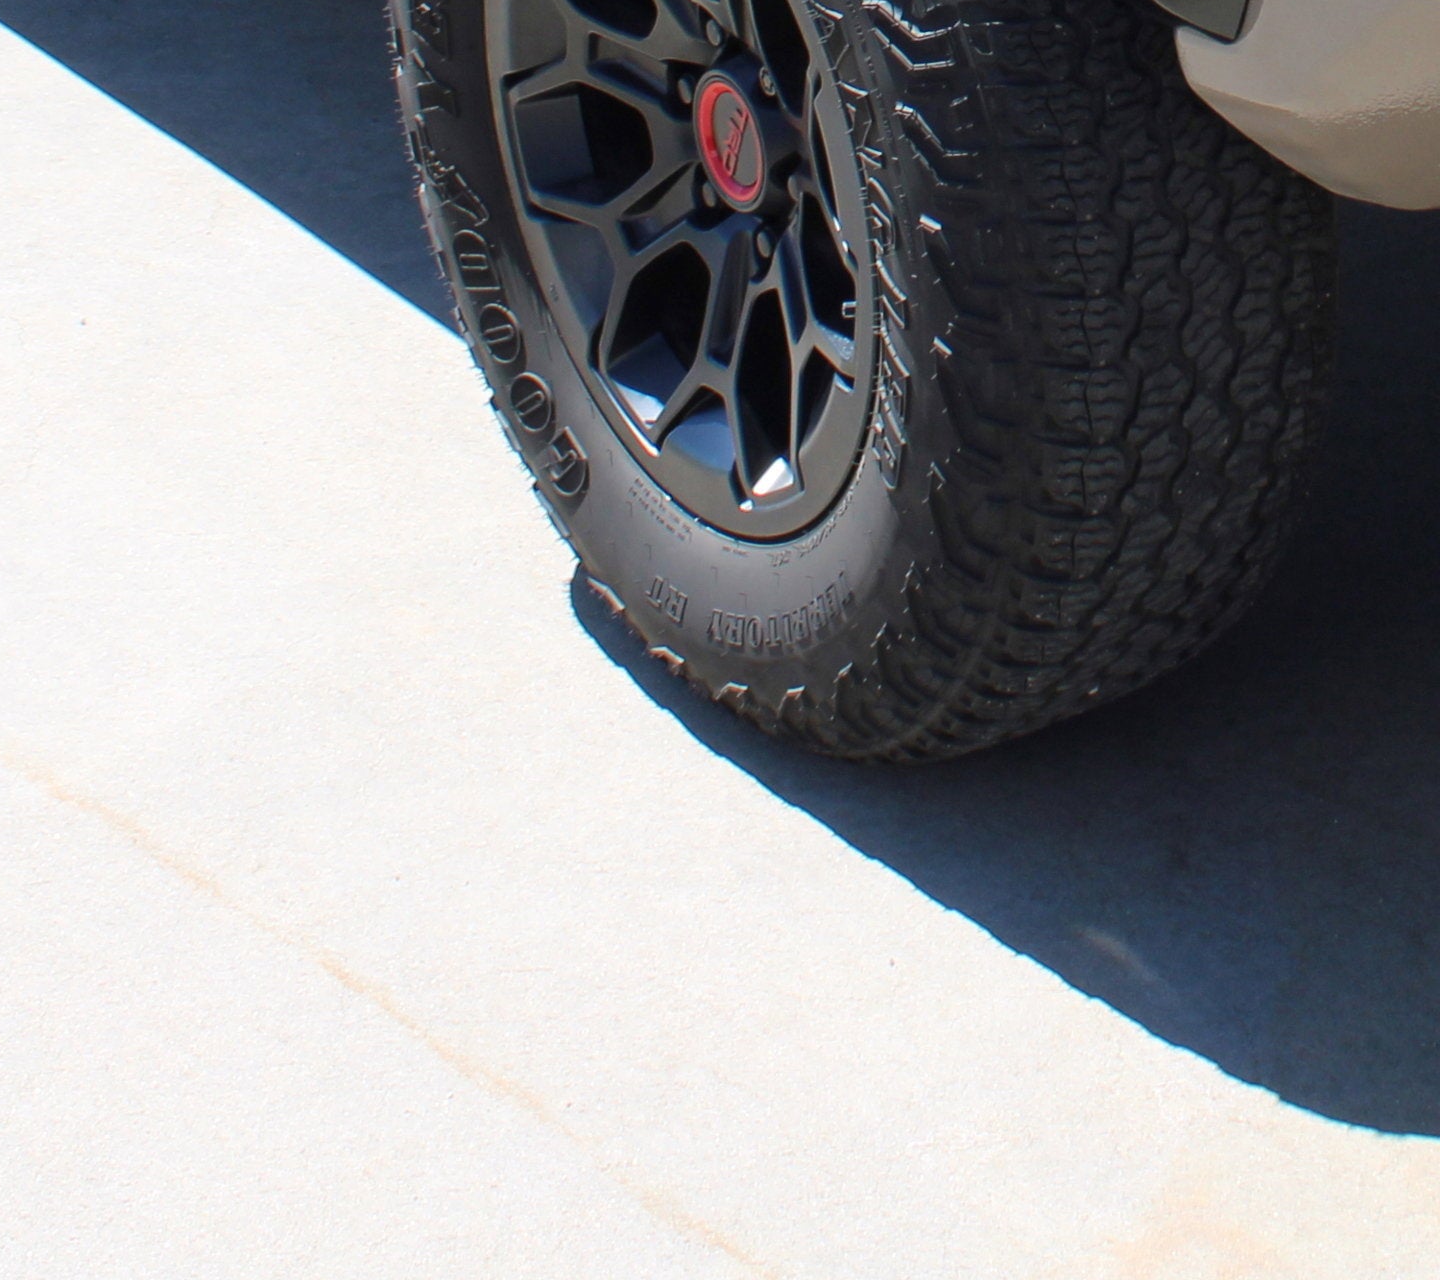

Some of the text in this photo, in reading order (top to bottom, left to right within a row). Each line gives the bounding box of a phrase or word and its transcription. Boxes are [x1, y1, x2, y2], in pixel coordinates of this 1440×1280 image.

[721, 104, 750, 178] TRD
[644, 569, 857, 649] TERRITORY RT
